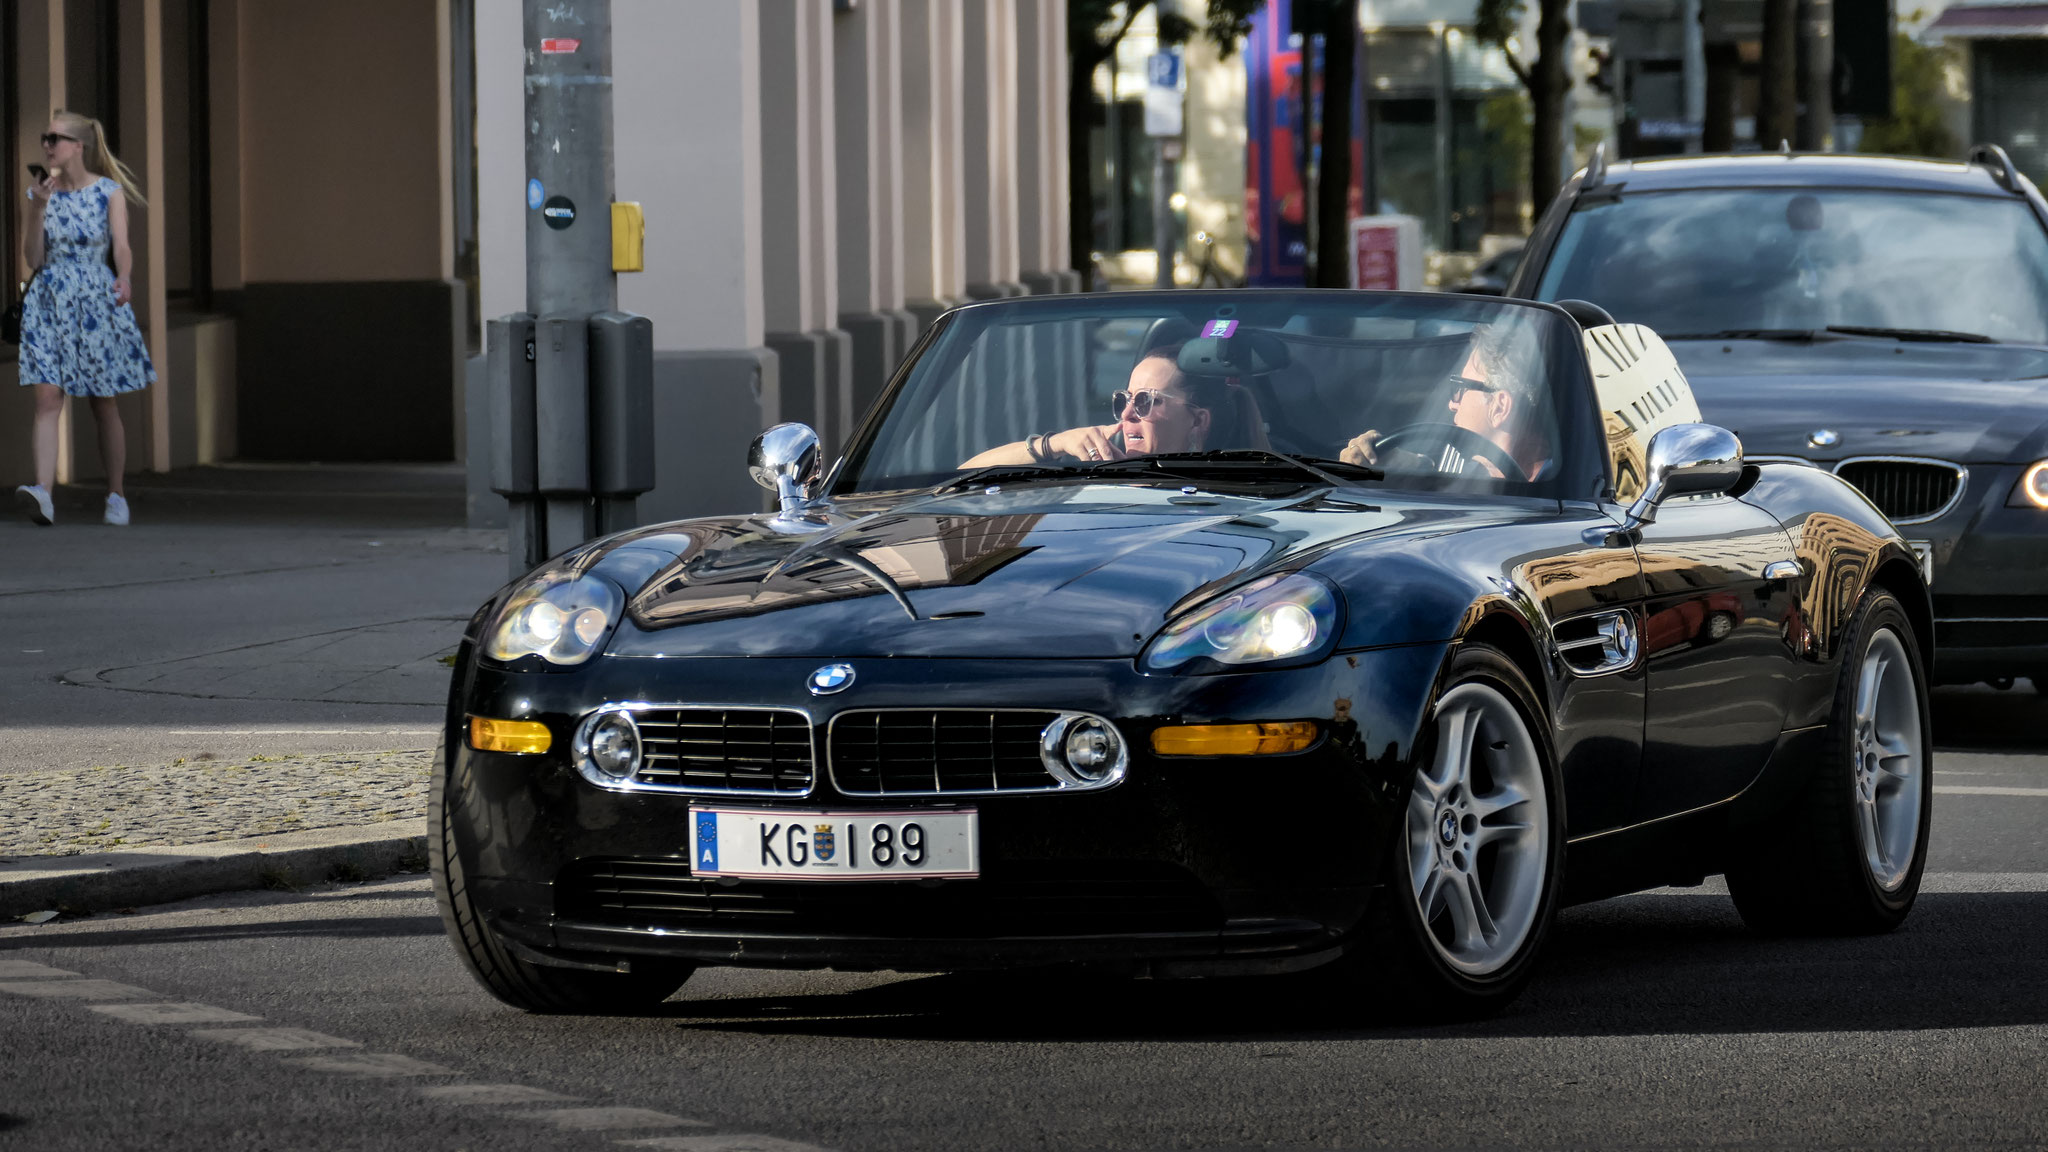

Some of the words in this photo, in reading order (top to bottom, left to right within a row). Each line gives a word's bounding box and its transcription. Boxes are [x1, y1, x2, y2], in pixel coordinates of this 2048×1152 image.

[1209, 327, 1227, 336] 22
[760, 823, 808, 867] KG
[702, 849, 713, 863] A
